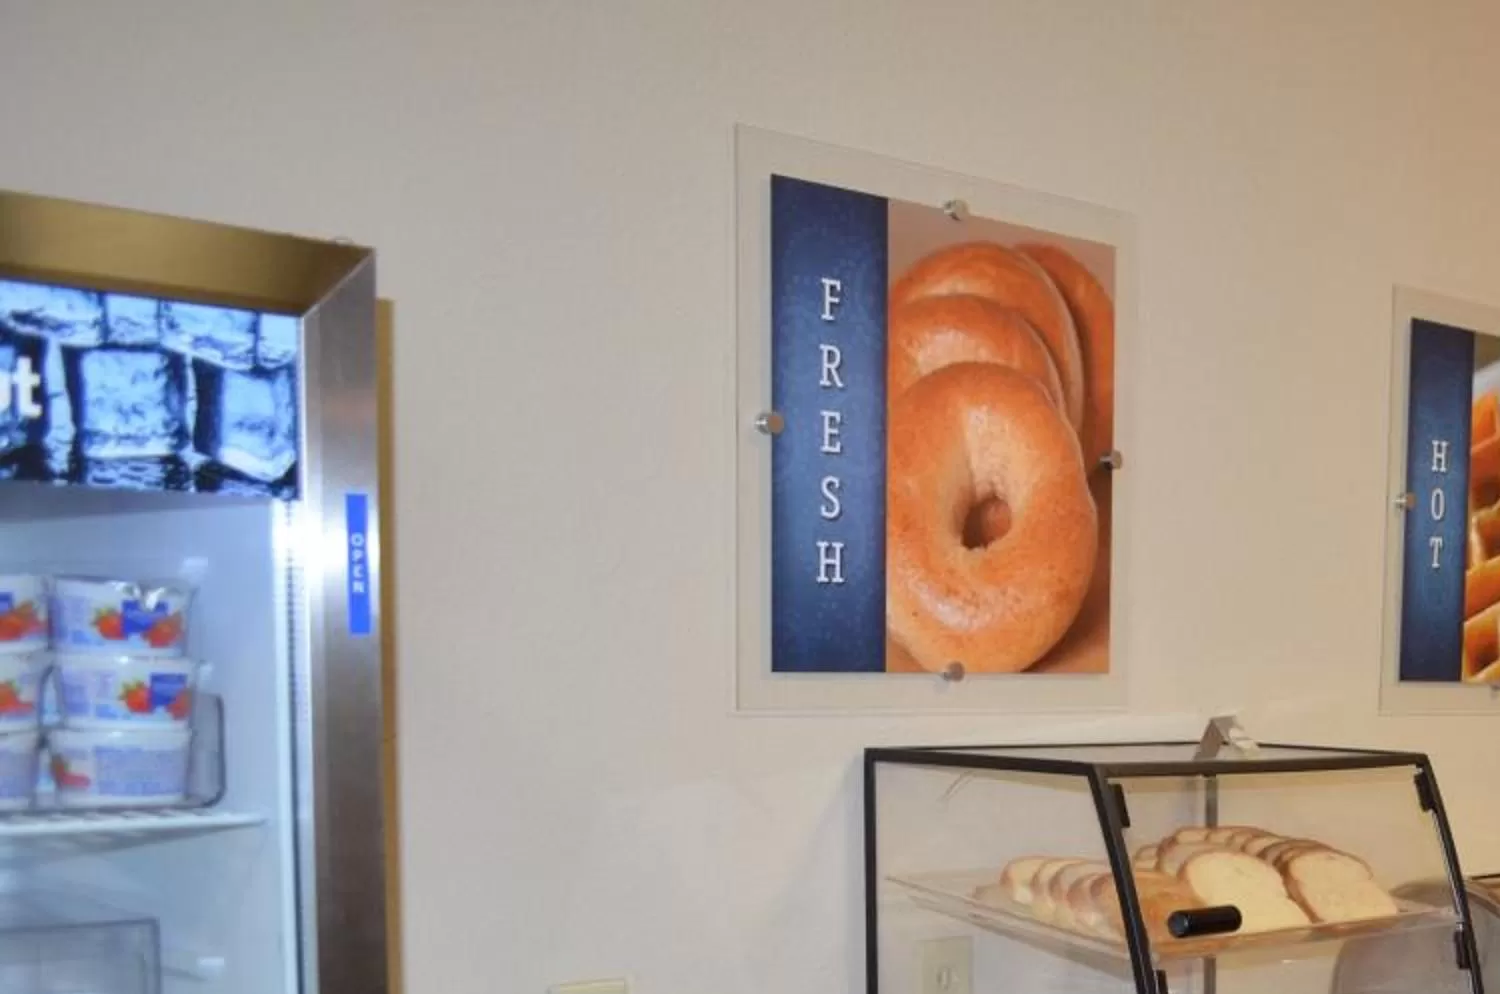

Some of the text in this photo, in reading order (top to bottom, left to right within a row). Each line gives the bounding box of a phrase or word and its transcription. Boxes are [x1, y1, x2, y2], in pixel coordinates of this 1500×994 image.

[0, 356, 43, 418] t
[817, 277, 845, 584] FRESH
[1430, 439, 1448, 569] HOT
[351, 532, 365, 593] OPEN
